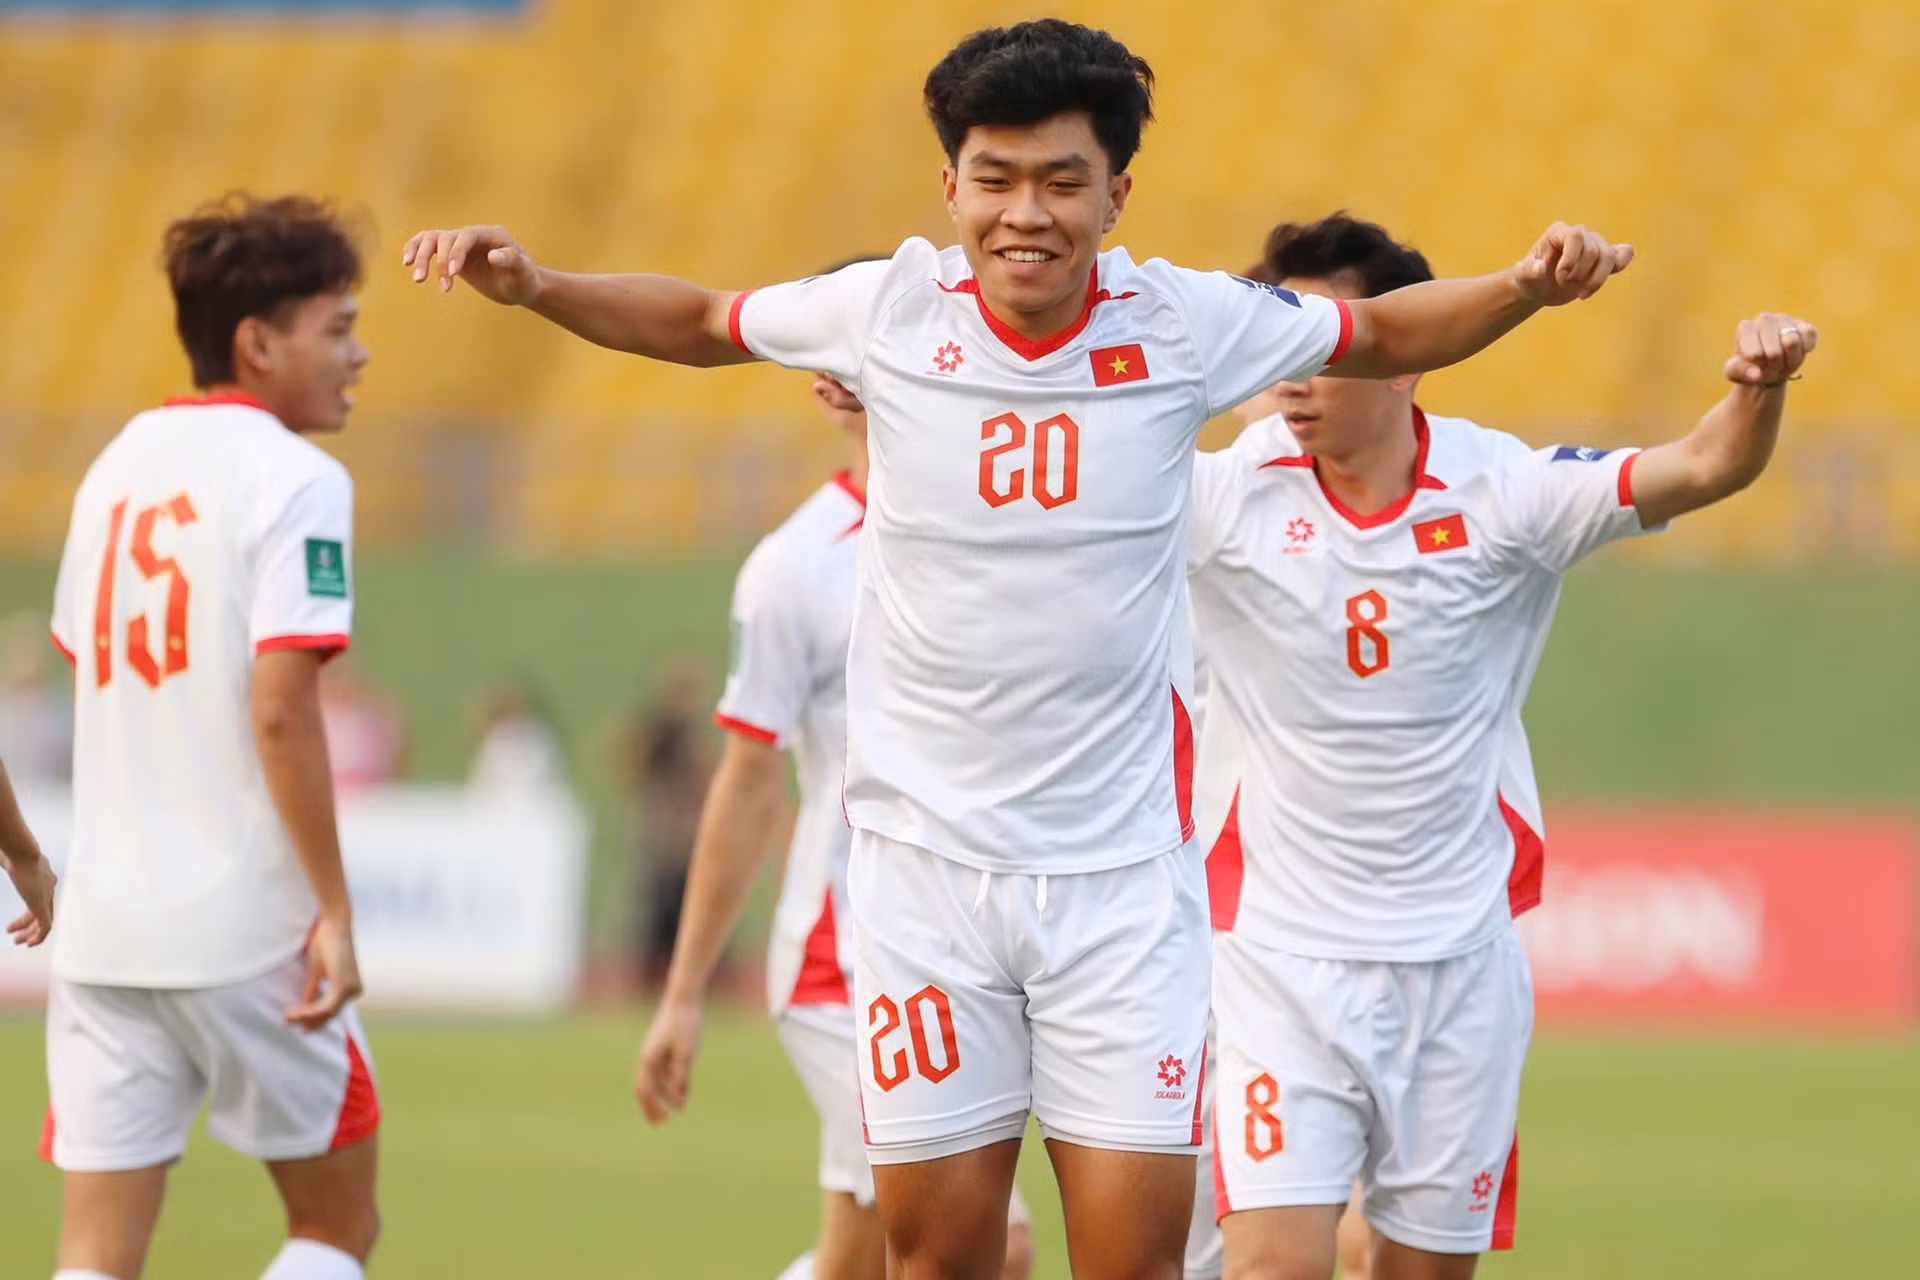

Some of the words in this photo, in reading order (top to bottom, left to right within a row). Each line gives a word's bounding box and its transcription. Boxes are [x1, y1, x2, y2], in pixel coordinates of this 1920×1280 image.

[979, 411, 1079, 510] 20
[95, 493, 197, 689] 15
[1346, 589, 1390, 678] 8
[869, 984, 960, 1092] 20
[1246, 1072, 1284, 1163] 8
